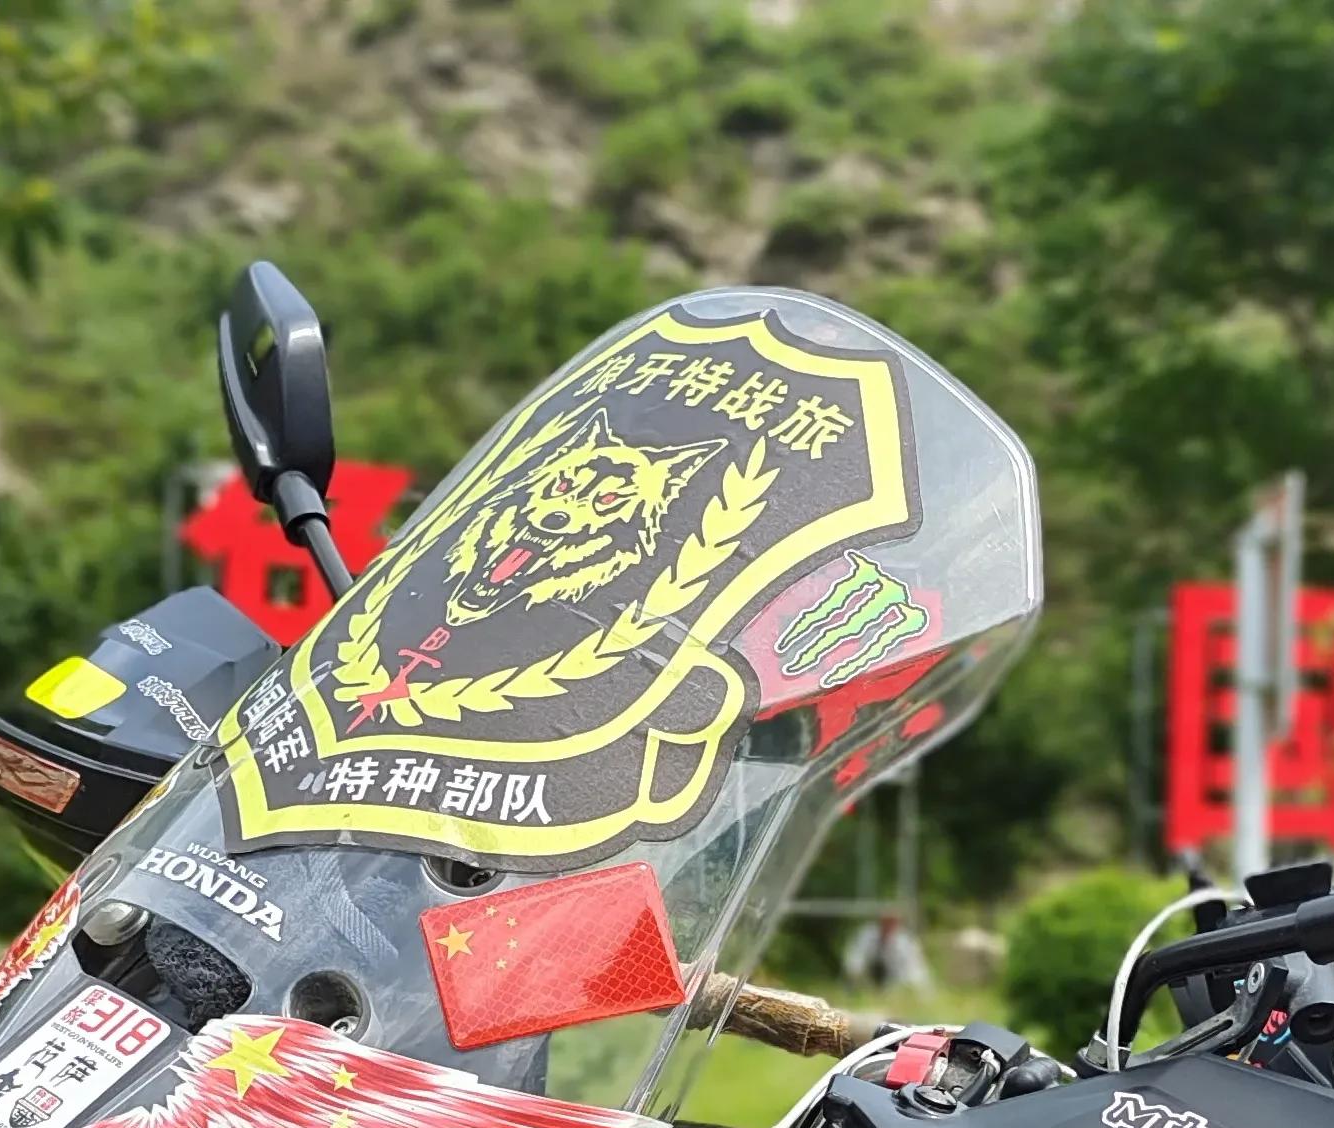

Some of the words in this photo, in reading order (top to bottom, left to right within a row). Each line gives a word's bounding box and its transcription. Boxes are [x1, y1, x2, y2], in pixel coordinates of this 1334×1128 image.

[573, 353, 854, 459] 狼牙特战旅
[325, 757, 552, 825] 特种部队
[136, 847, 284, 942] HONDA
[187, 842, 268, 888] WUYANG
[77, 996, 162, 1056] 318
[23, 1037, 99, 1088] 拉萨
